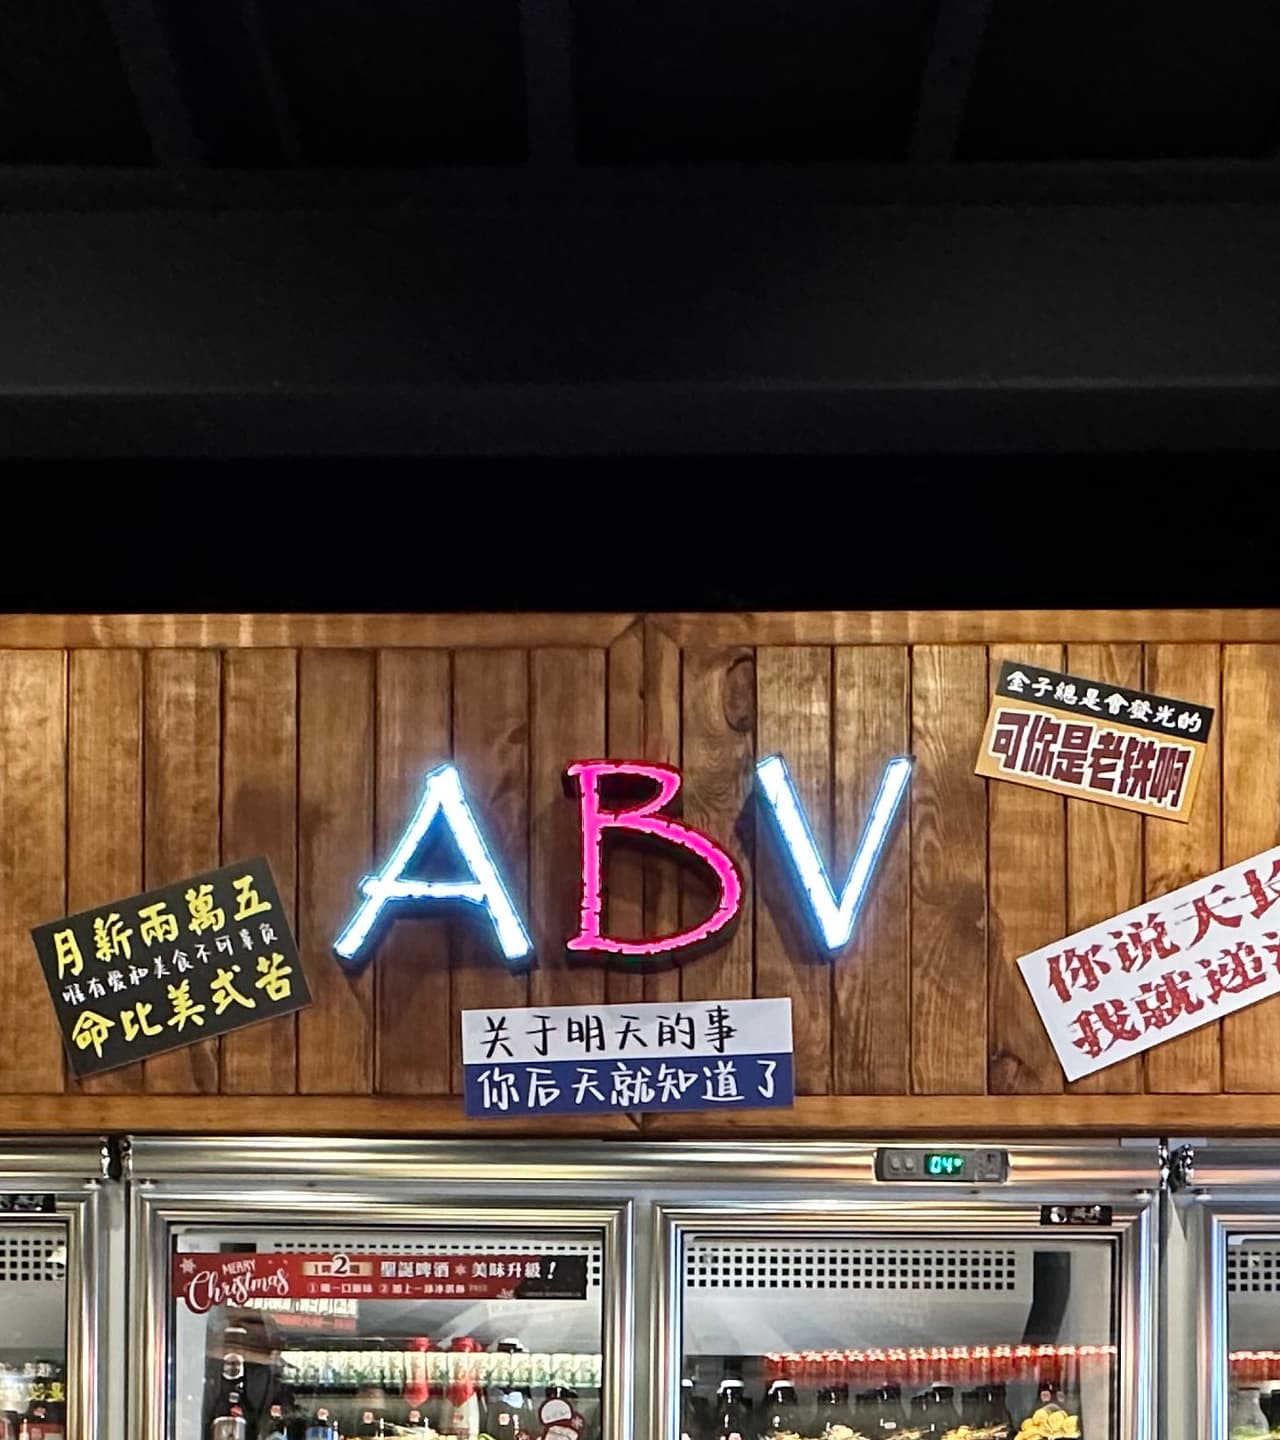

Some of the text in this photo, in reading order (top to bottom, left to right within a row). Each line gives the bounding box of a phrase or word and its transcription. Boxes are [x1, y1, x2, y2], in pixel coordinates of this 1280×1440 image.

[1006, 670, 1203, 734] 金子總是會發光的
[332, 752, 914, 960] ABV
[72, 951, 294, 1058] 命比美式苦
[479, 1005, 739, 1059] 关于明天的事
[476, 1059, 778, 1109] 你后天就知道了
[188, 1268, 290, 1311] Christmas
[222, 1258, 257, 1276] MERRY
